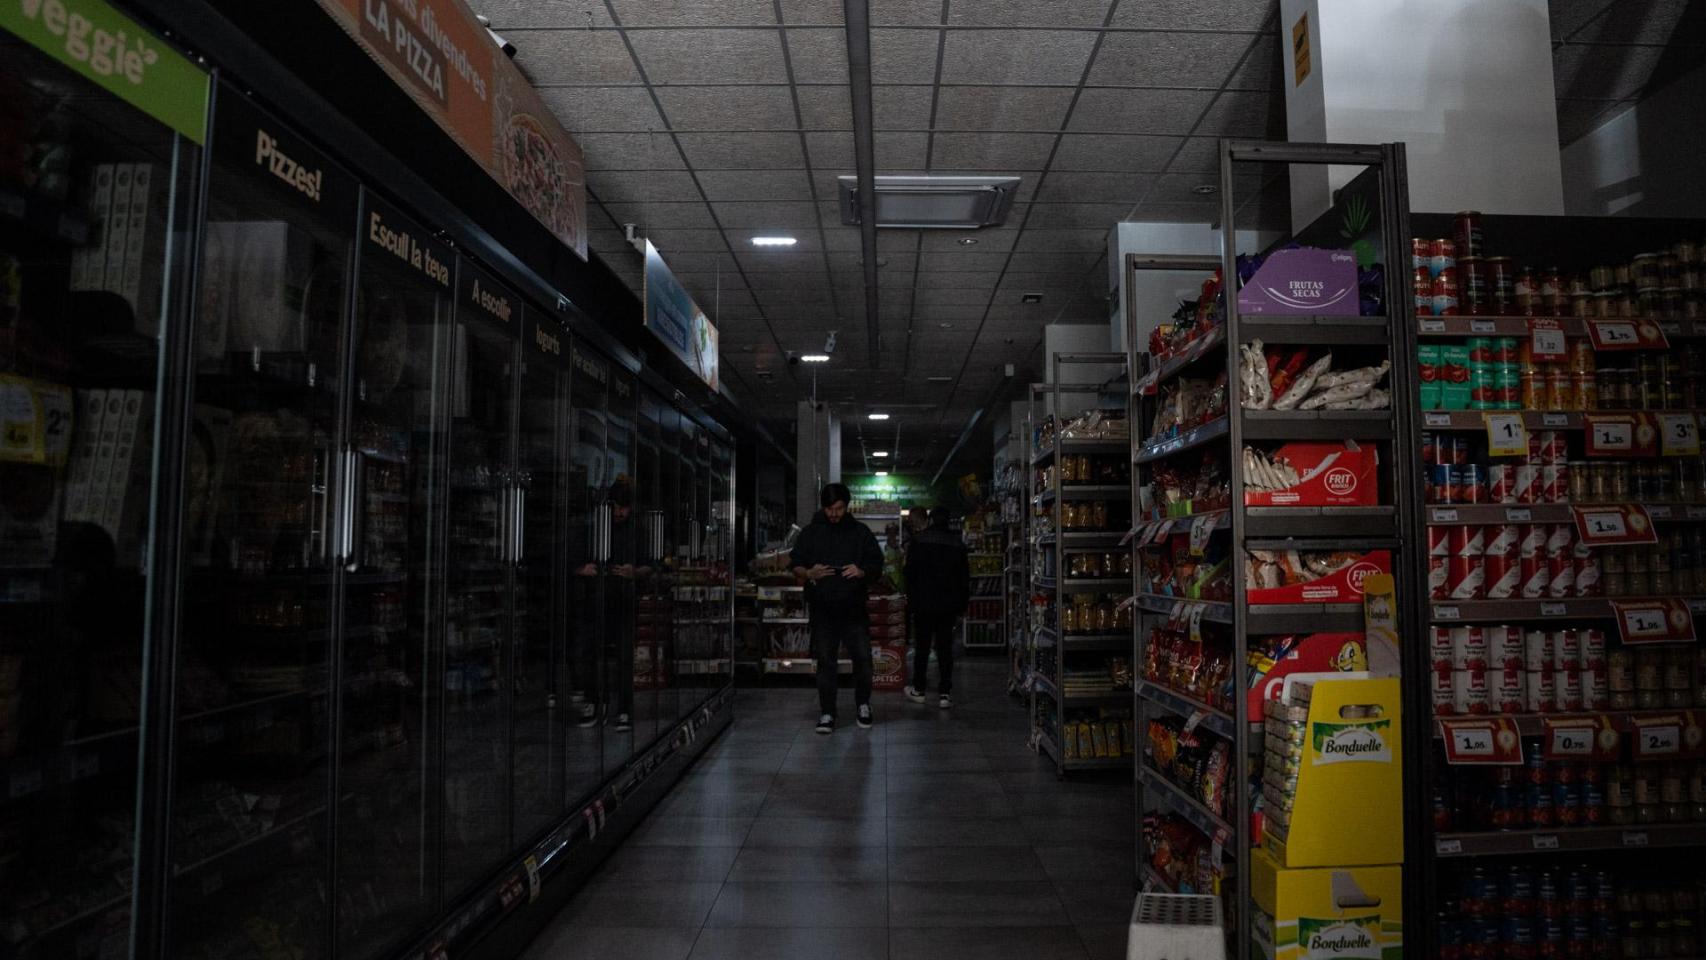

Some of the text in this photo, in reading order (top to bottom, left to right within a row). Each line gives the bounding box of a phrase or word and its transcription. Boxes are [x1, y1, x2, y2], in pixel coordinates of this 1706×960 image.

[394, 18, 444, 101] PIZZA
[256, 129, 322, 203] Pizzes!
[370, 211, 449, 287] Escull la teva
[471, 279, 480, 305] A
[1289, 281, 1324, 290] FRUTAS
[1292, 290, 1321, 298] SECAS
[1329, 474, 1351, 484] FRIT
[1325, 739, 1382, 757] Bonduelle
[1311, 934, 1372, 953] Bonduelle
